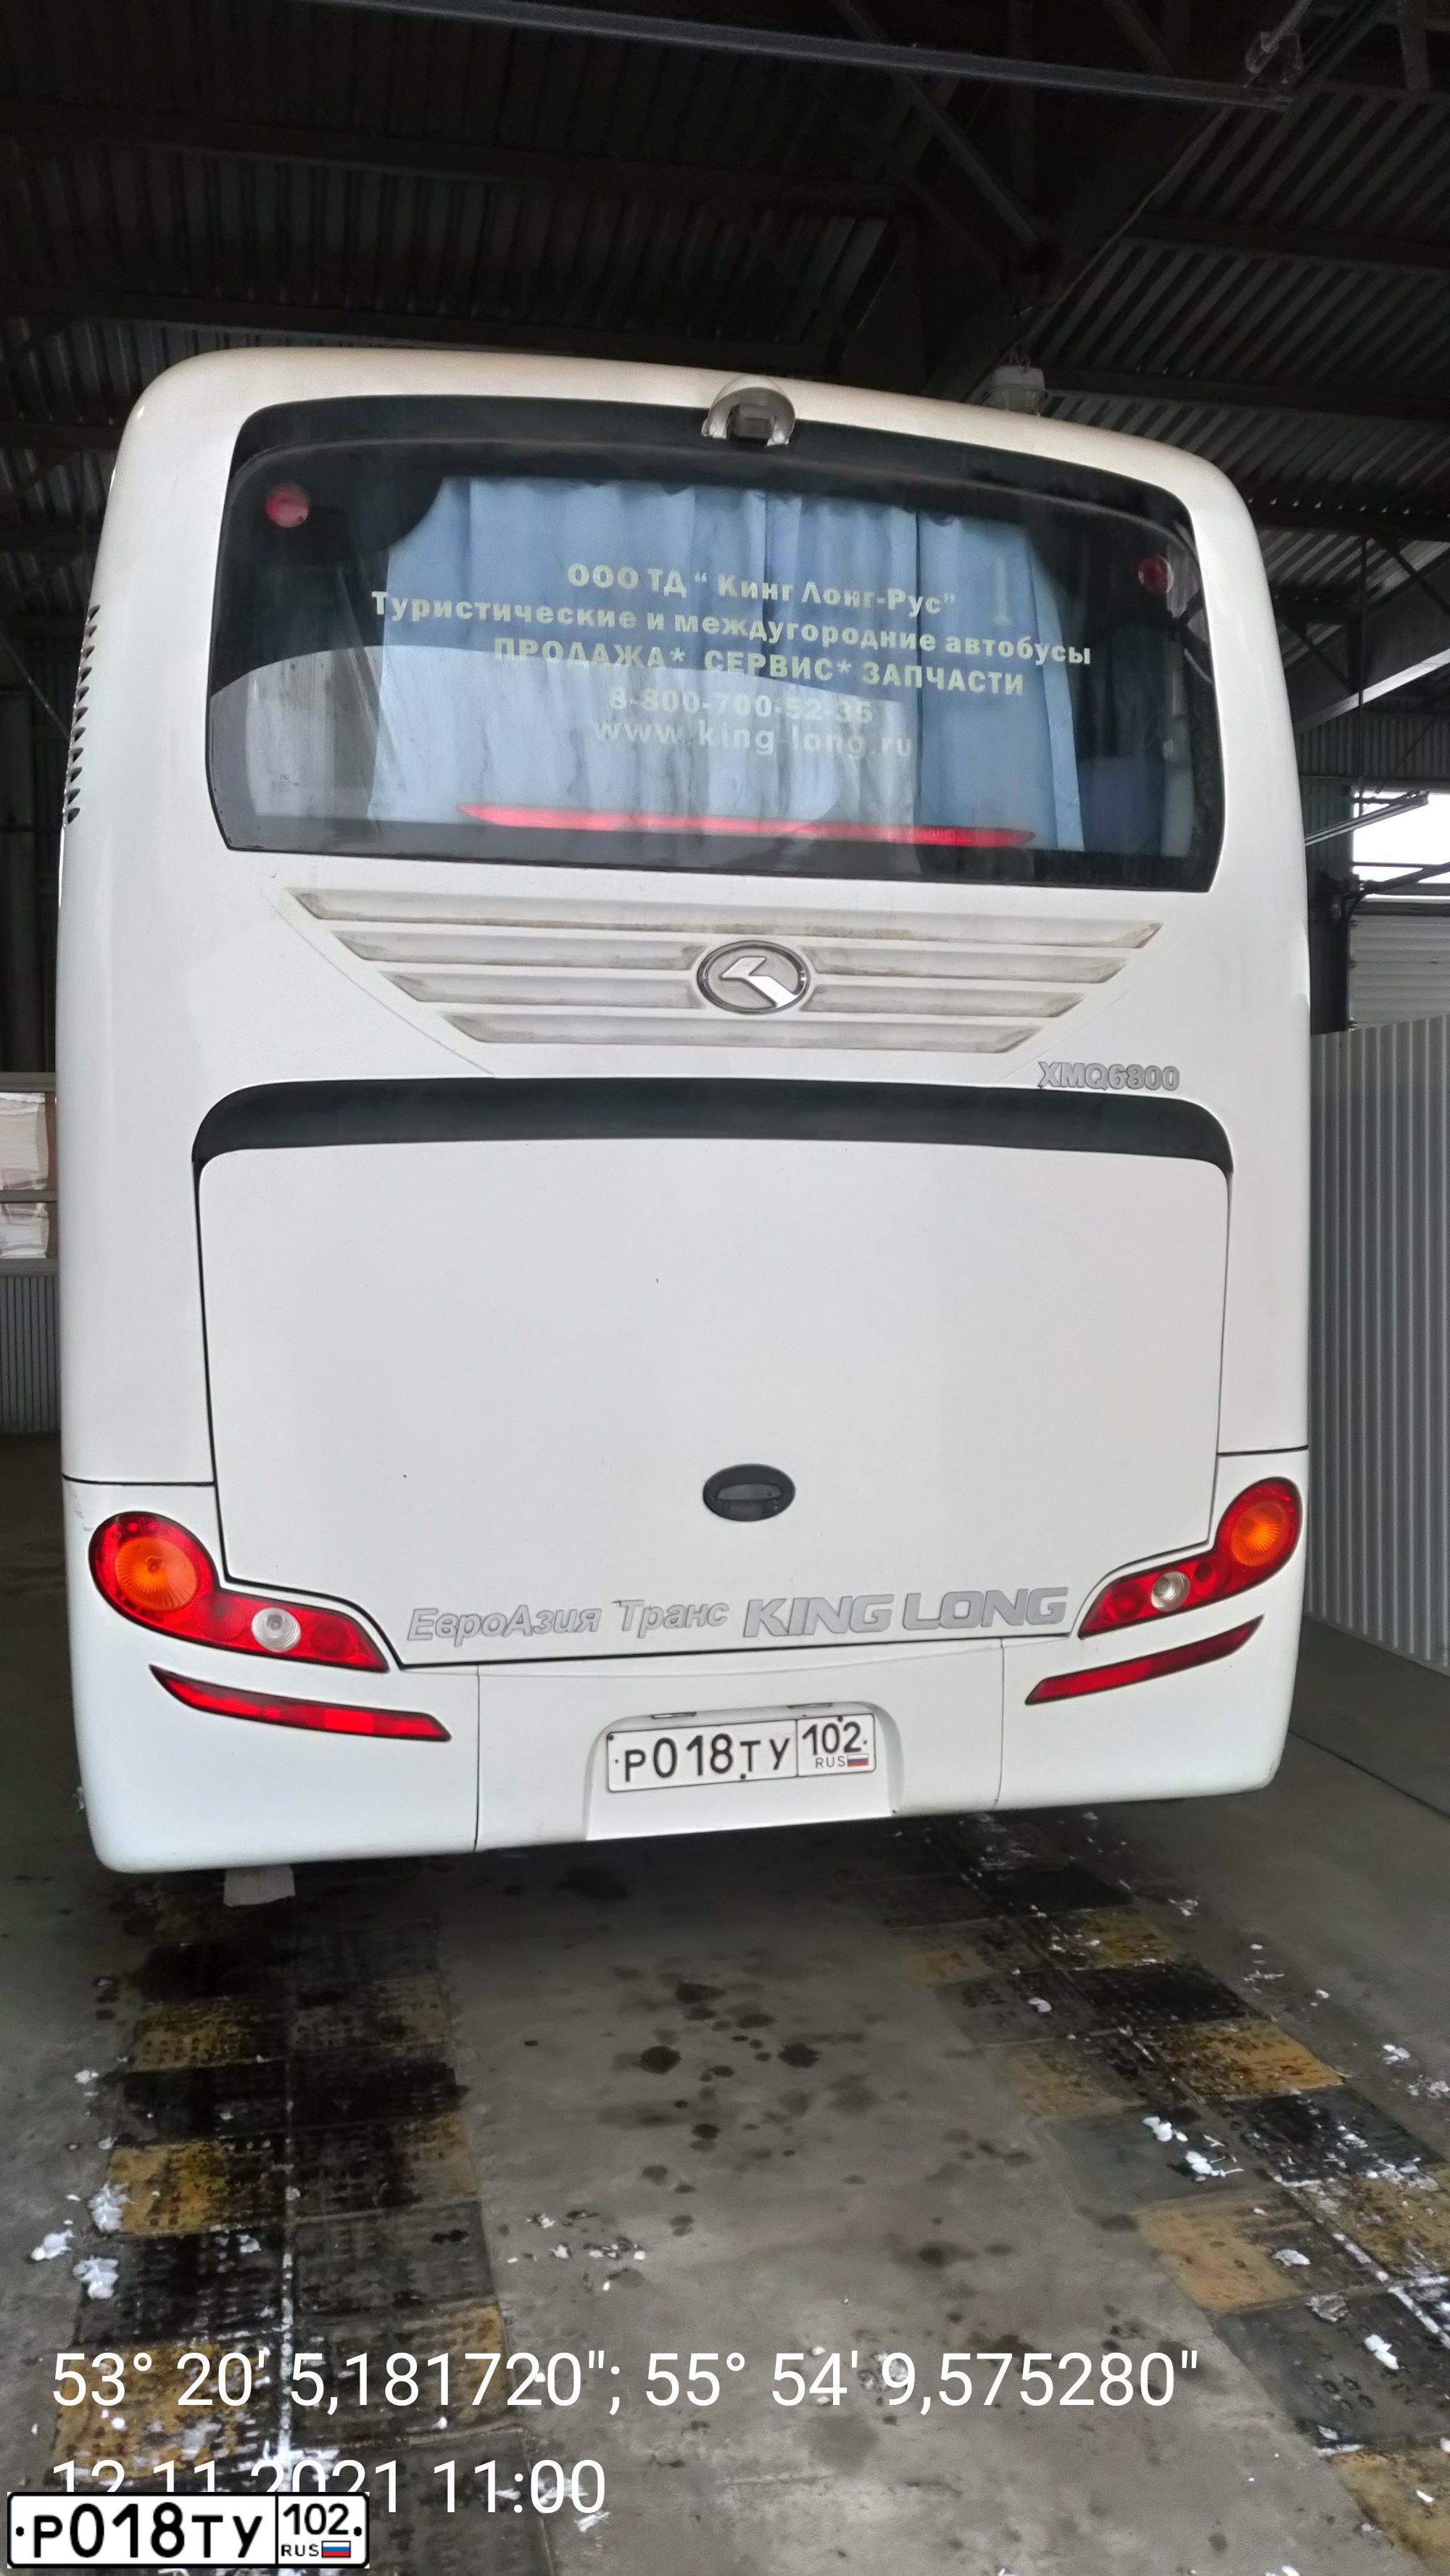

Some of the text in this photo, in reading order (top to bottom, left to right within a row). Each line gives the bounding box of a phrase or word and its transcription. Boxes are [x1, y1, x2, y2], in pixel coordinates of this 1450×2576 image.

[568, 563, 639, 590] ООО
[647, 568, 687, 598] ТД
[371, 590, 1090, 665] Туристические и междугородние автобусы
[862, 661, 1024, 695] ЗАПЧАСТИ
[1037, 1061, 1180, 1091] XMQ6800
[407, 1600, 729, 1647] ЕвроАзия Транс
[743, 1587, 1069, 1637] KING LONG
[802, 1721, 862, 1756] 102
[816, 1756, 846, 1769] RUS
